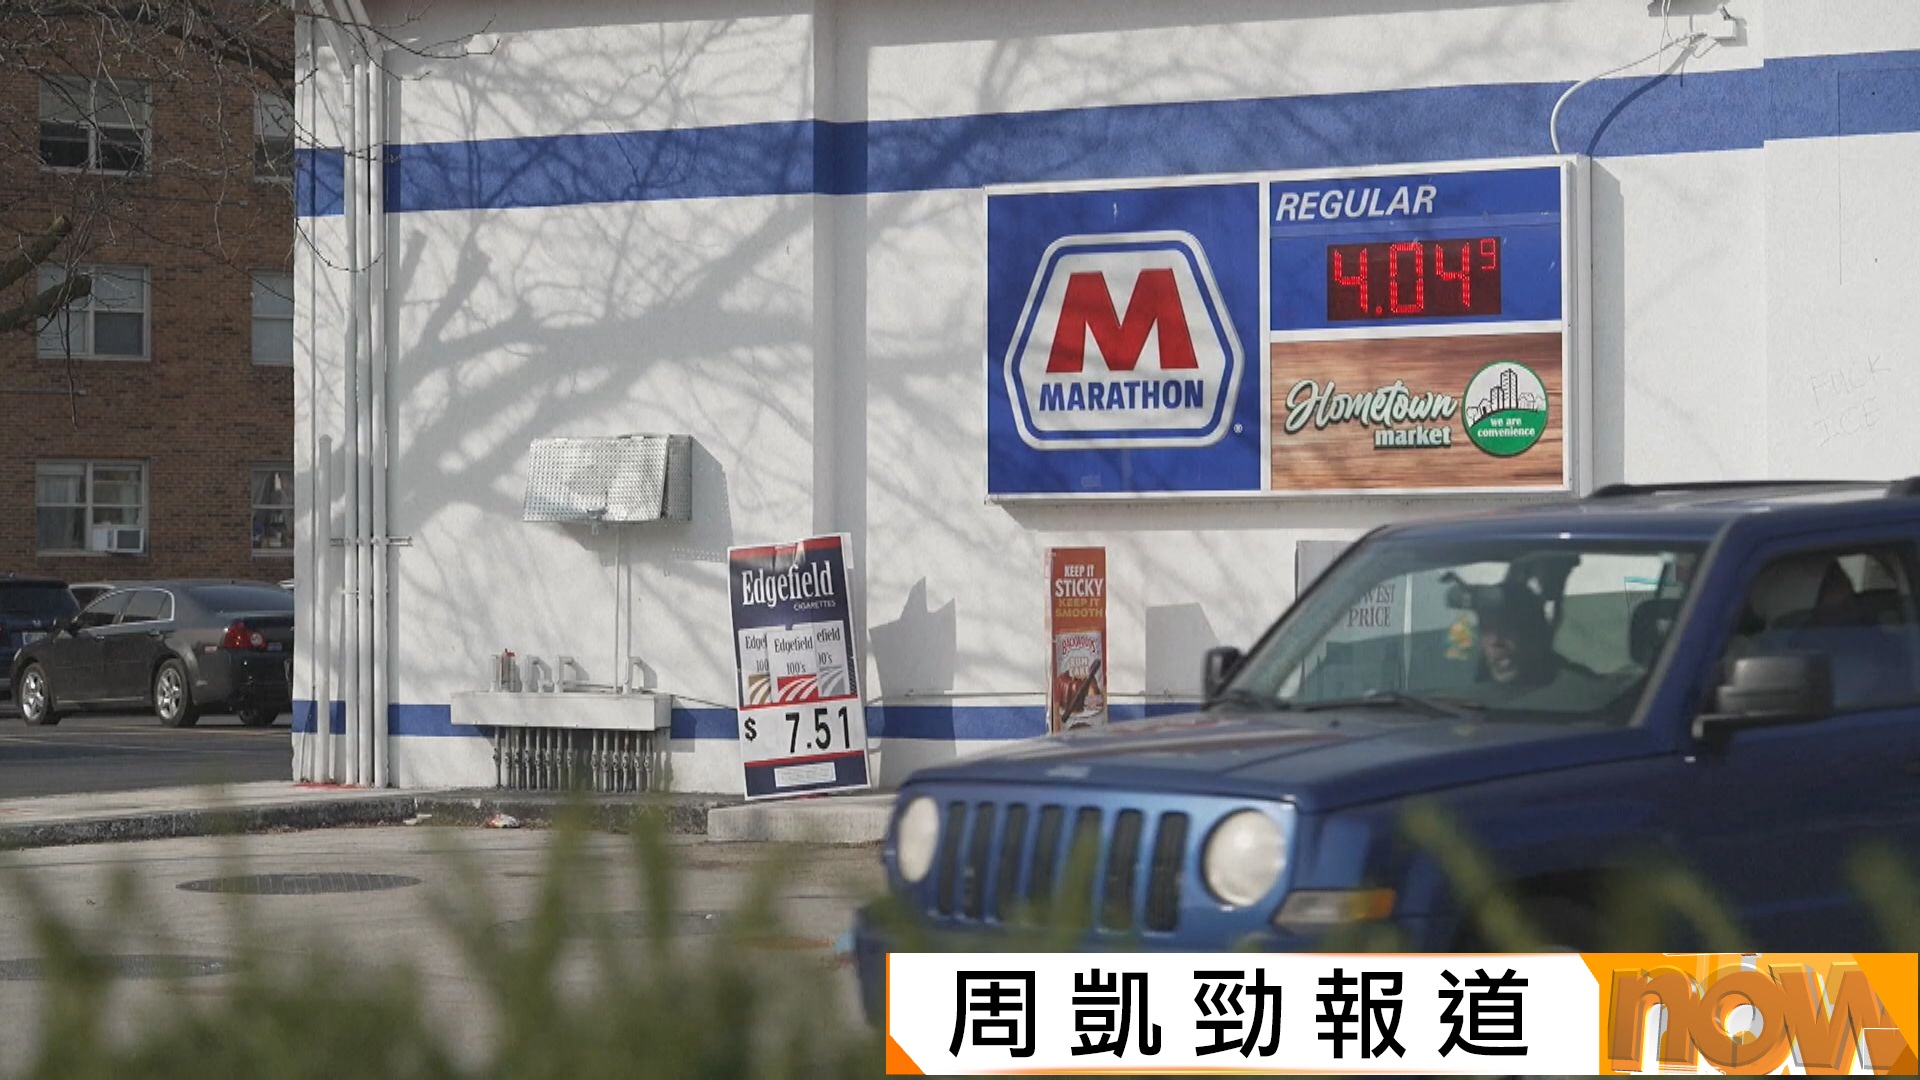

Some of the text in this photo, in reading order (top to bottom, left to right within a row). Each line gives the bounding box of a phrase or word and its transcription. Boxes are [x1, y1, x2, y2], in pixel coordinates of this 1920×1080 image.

[1276, 184, 1437, 221] REGULAR
[1334, 242, 1471, 315] 4.04
[1039, 380, 1204, 412] MARATHON
[1285, 378, 1459, 434] Hometown
[1490, 416, 1522, 427] we are
[1374, 426, 1452, 449] market
[1477, 426, 1536, 438] convenience
[1064, 564, 1095, 578] KEEP IT
[742, 560, 834, 607] Edgefield
[1055, 578, 1104, 598] STICKY
[794, 600, 836, 612] CIGARETTES
[1055, 608, 1103, 618] SMOOTH
[1059, 598, 1100, 608] KEEP IT
[1347, 606, 1392, 628] PRICE
[774, 636, 813, 654] Edgefield
[786, 662, 807, 674] 100's
[744, 706, 851, 754] $ 7.51
